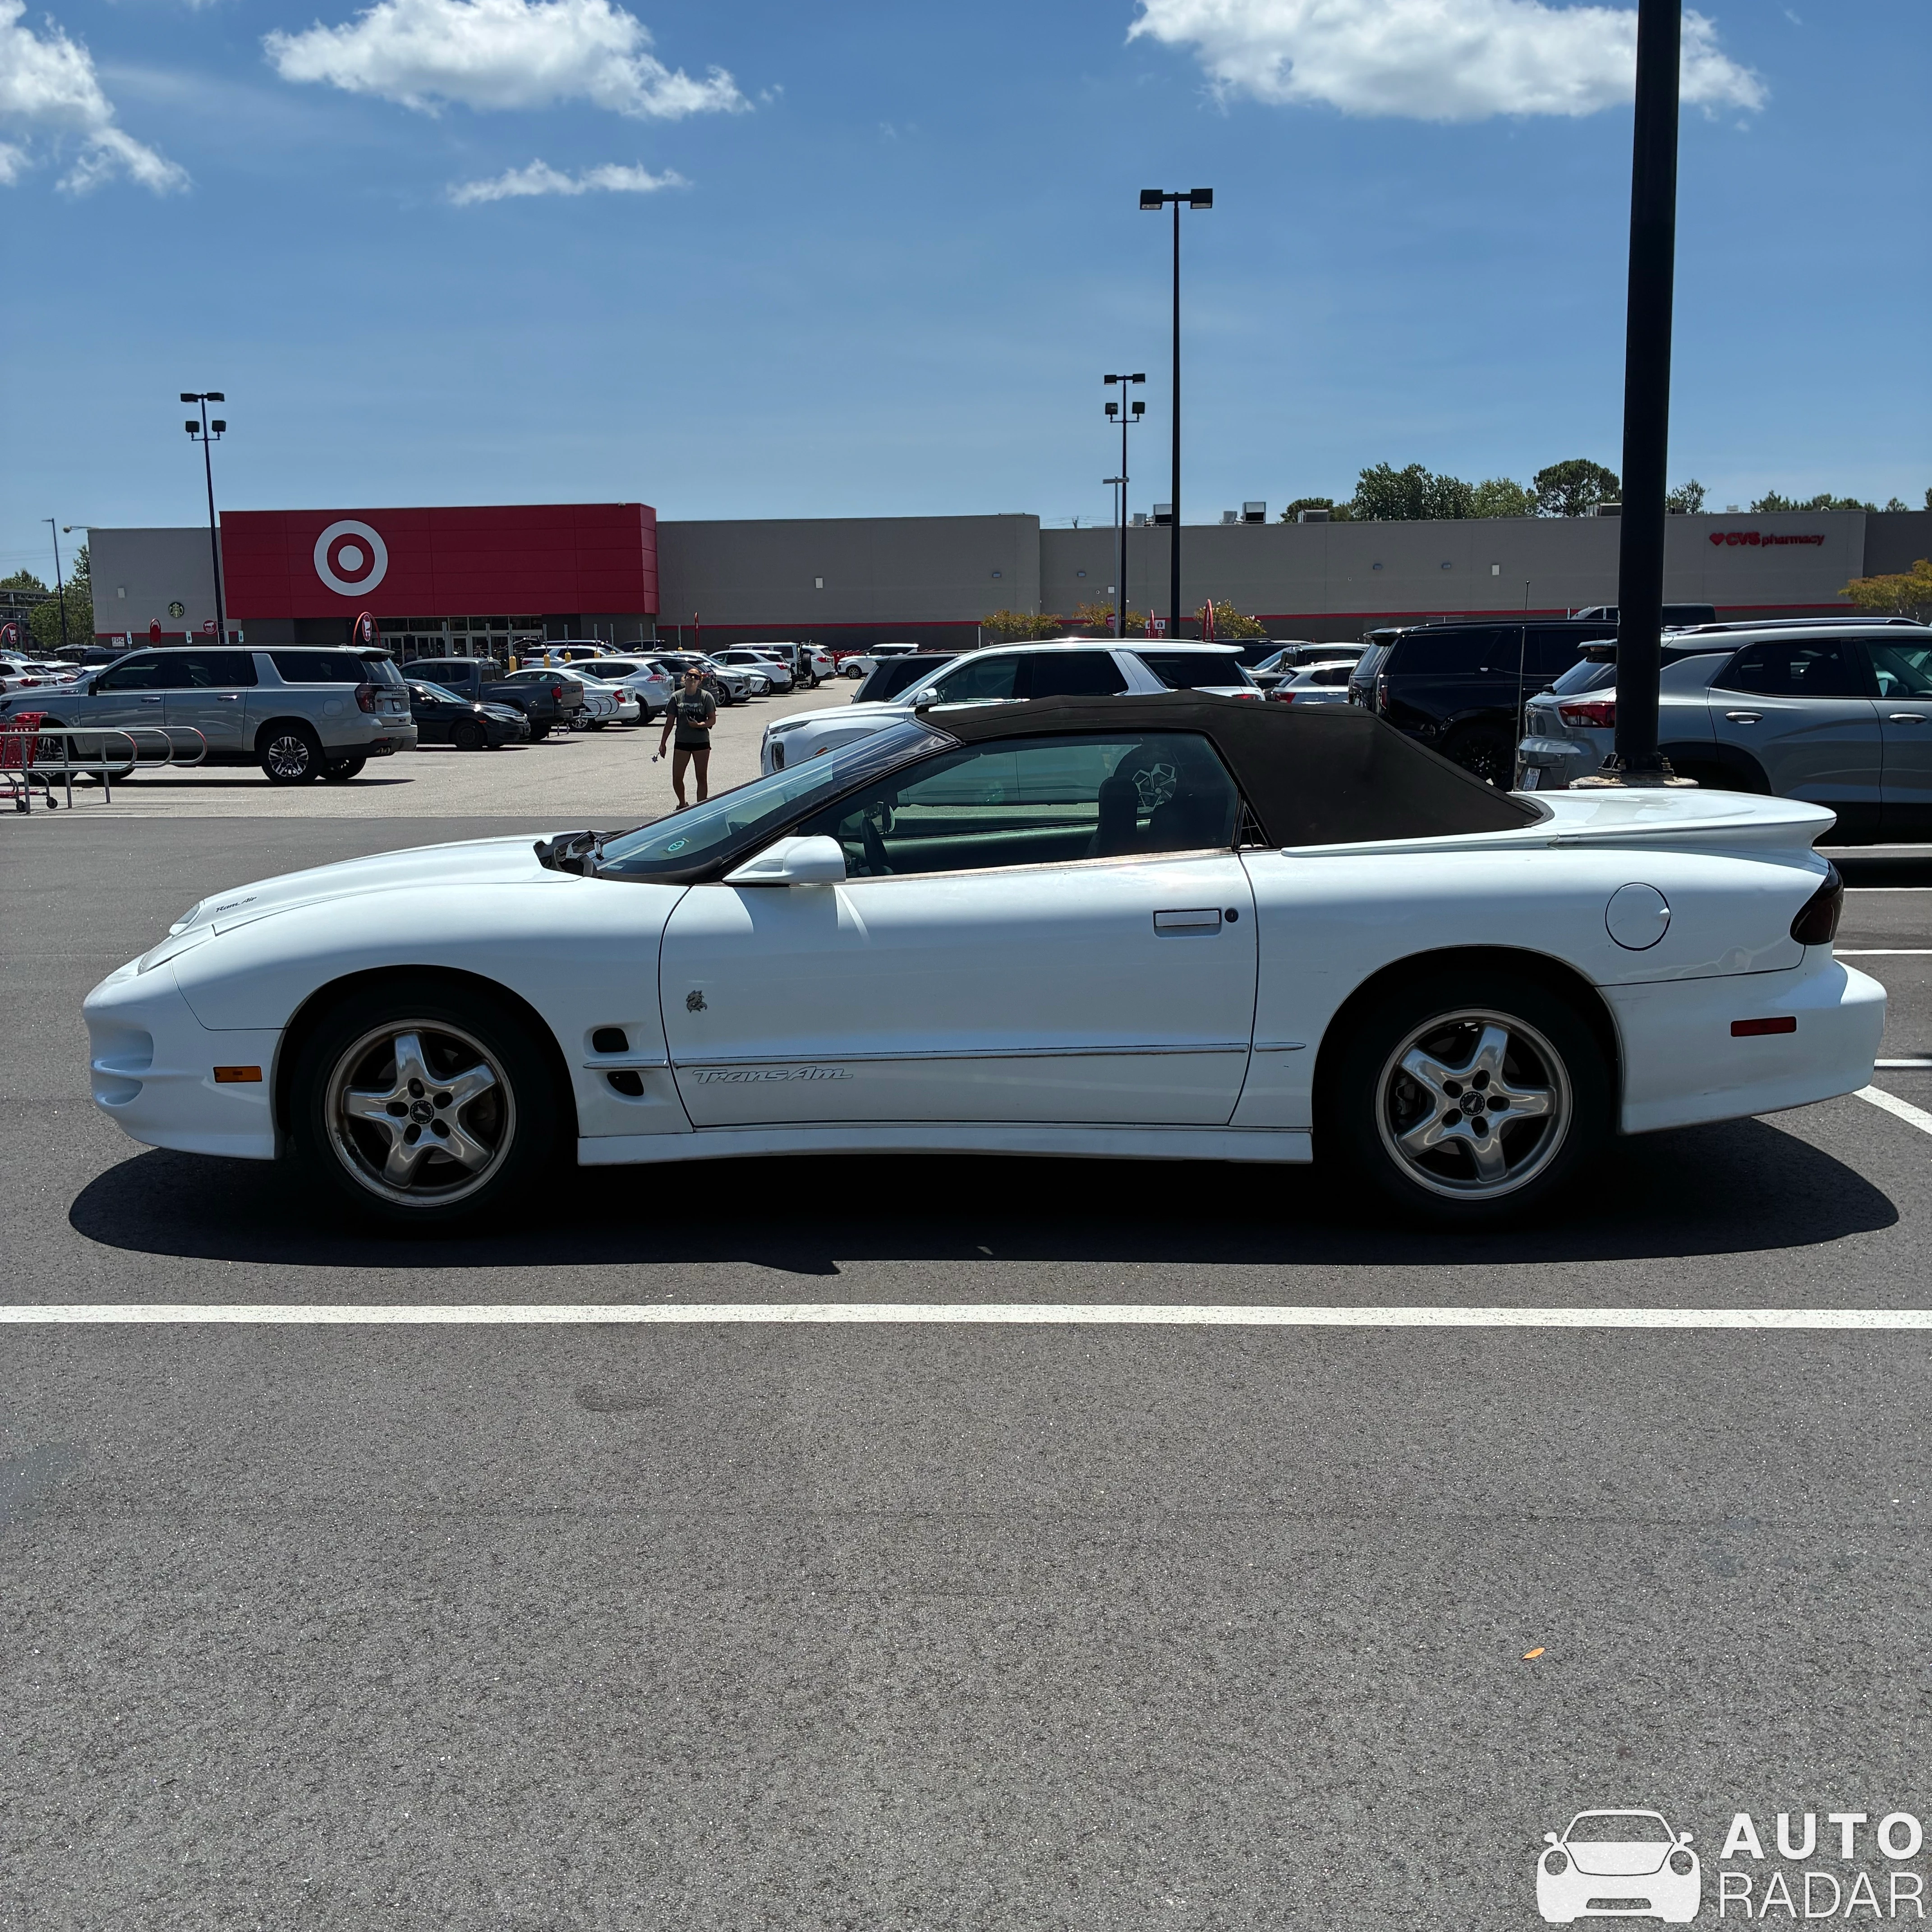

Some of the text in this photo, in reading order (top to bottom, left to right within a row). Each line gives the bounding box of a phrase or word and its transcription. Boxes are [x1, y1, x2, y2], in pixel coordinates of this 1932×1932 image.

[1725, 532, 1825, 547] CVS pharmacy
[216, 902, 241, 913] Ram
